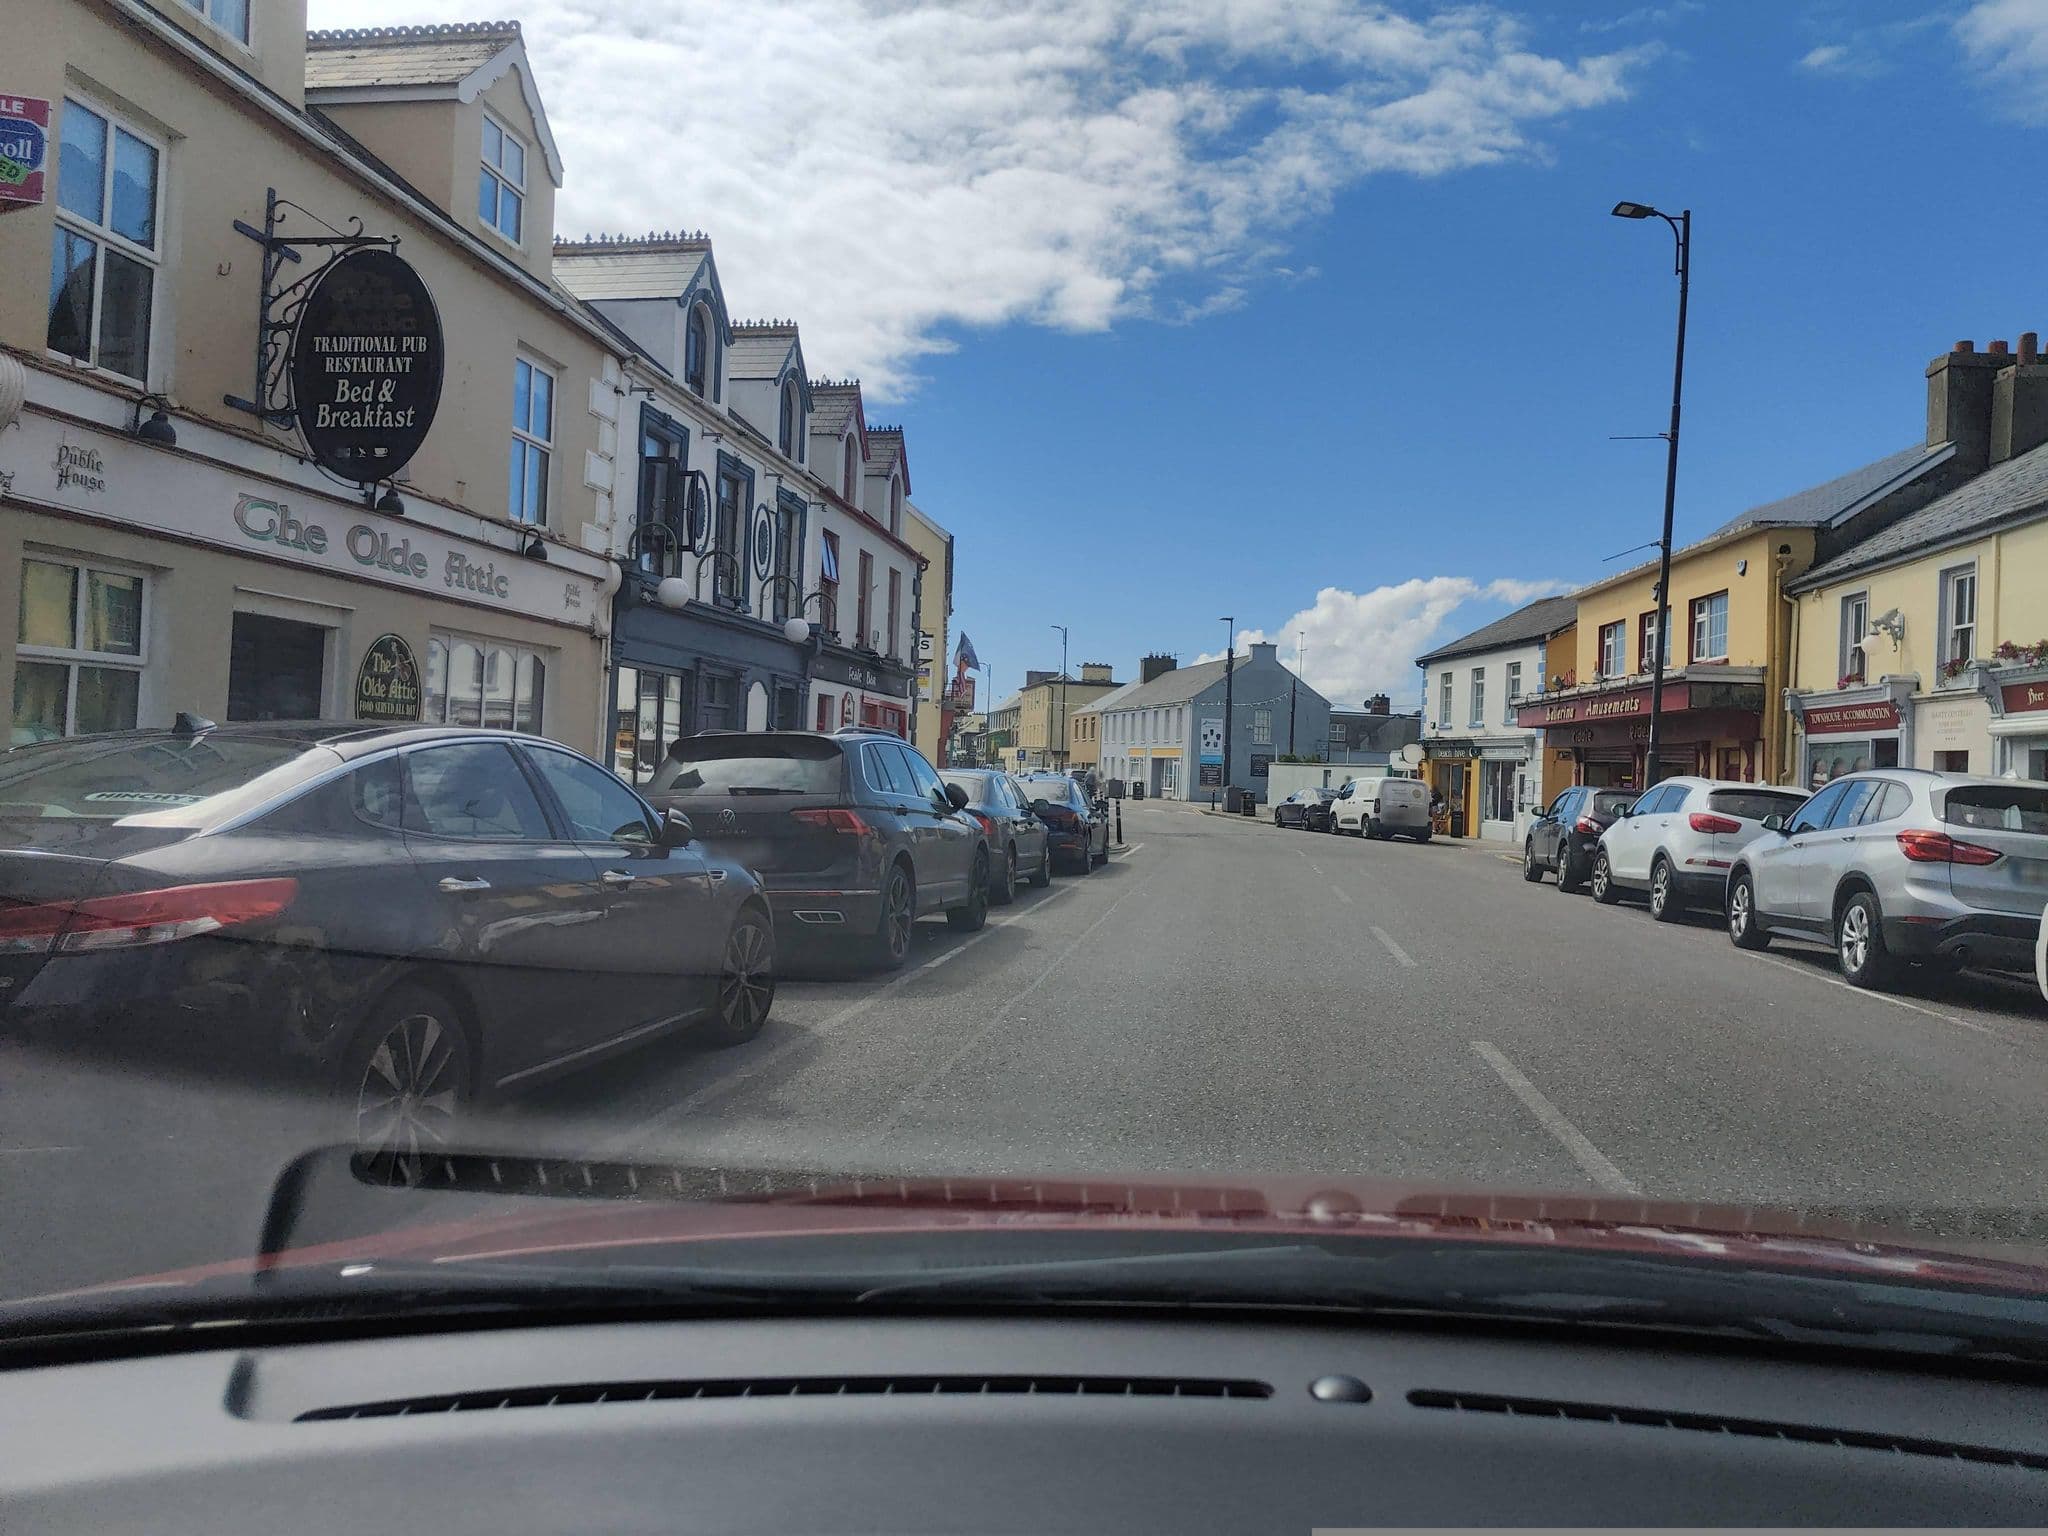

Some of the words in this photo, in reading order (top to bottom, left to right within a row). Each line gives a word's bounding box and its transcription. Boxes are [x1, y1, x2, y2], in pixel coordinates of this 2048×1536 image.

[313, 335, 397, 353] TRADITIONAL
[402, 335, 428, 353] PUB
[324, 356, 413, 373] RESTAURANT
[334, 378, 375, 403] Bed
[377, 377, 397, 403] &
[315, 403, 416, 428] Breakfast
[56, 444, 104, 474] Public
[56, 464, 106, 492] House
[234, 491, 329, 556] The
[345, 523, 429, 579] Olde
[444, 550, 509, 599] Attic
[373, 652, 392, 673] The
[362, 675, 387, 698] Olde
[388, 678, 417, 700] Attic
[2027, 687, 2045, 705] Beer
[359, 700, 374, 713] FOOD
[1585, 696, 1640, 717] Amusements
[1809, 711, 1841, 725] TOWNHOUSE
[1843, 707, 1891, 721] ACCOMMODATION
